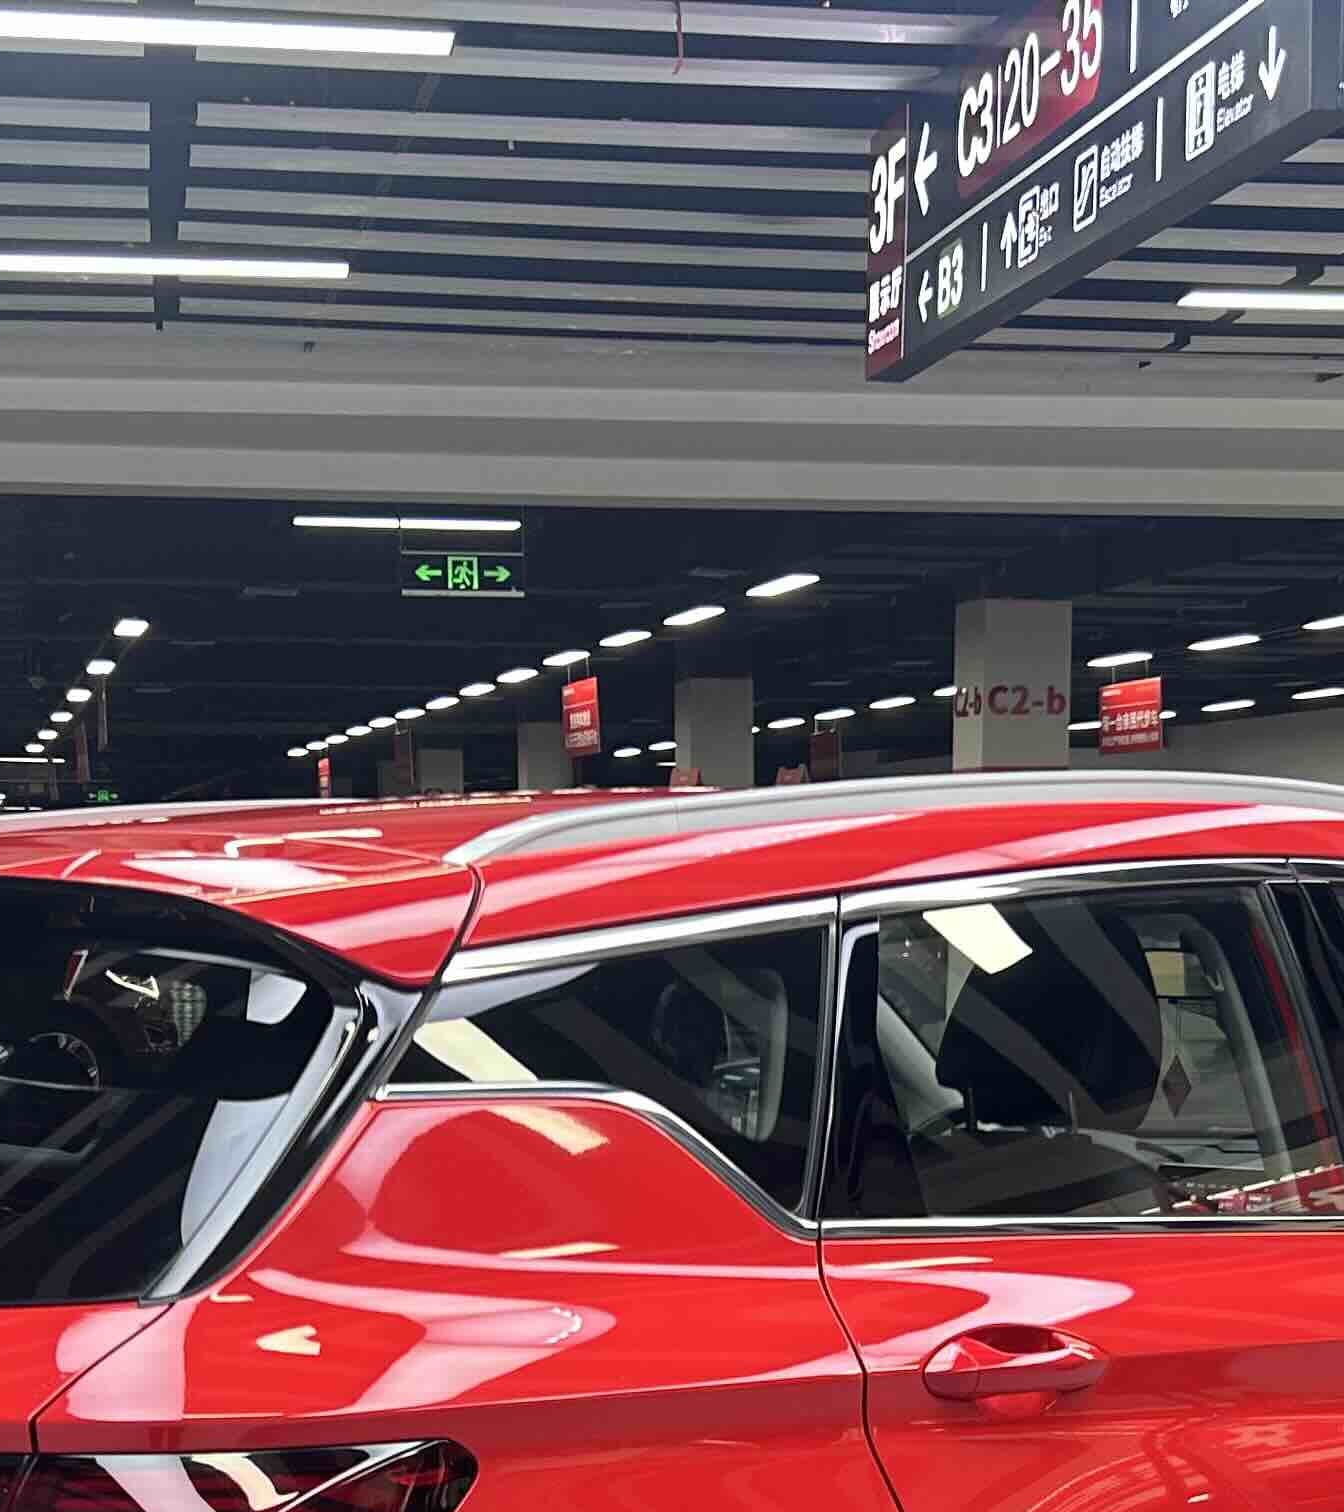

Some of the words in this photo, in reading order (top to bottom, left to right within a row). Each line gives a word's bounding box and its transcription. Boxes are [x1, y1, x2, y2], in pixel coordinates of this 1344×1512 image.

[869, 137, 906, 254] 3F
[937, 242, 964, 316] B3
[988, 685, 1067, 716] C2-b
